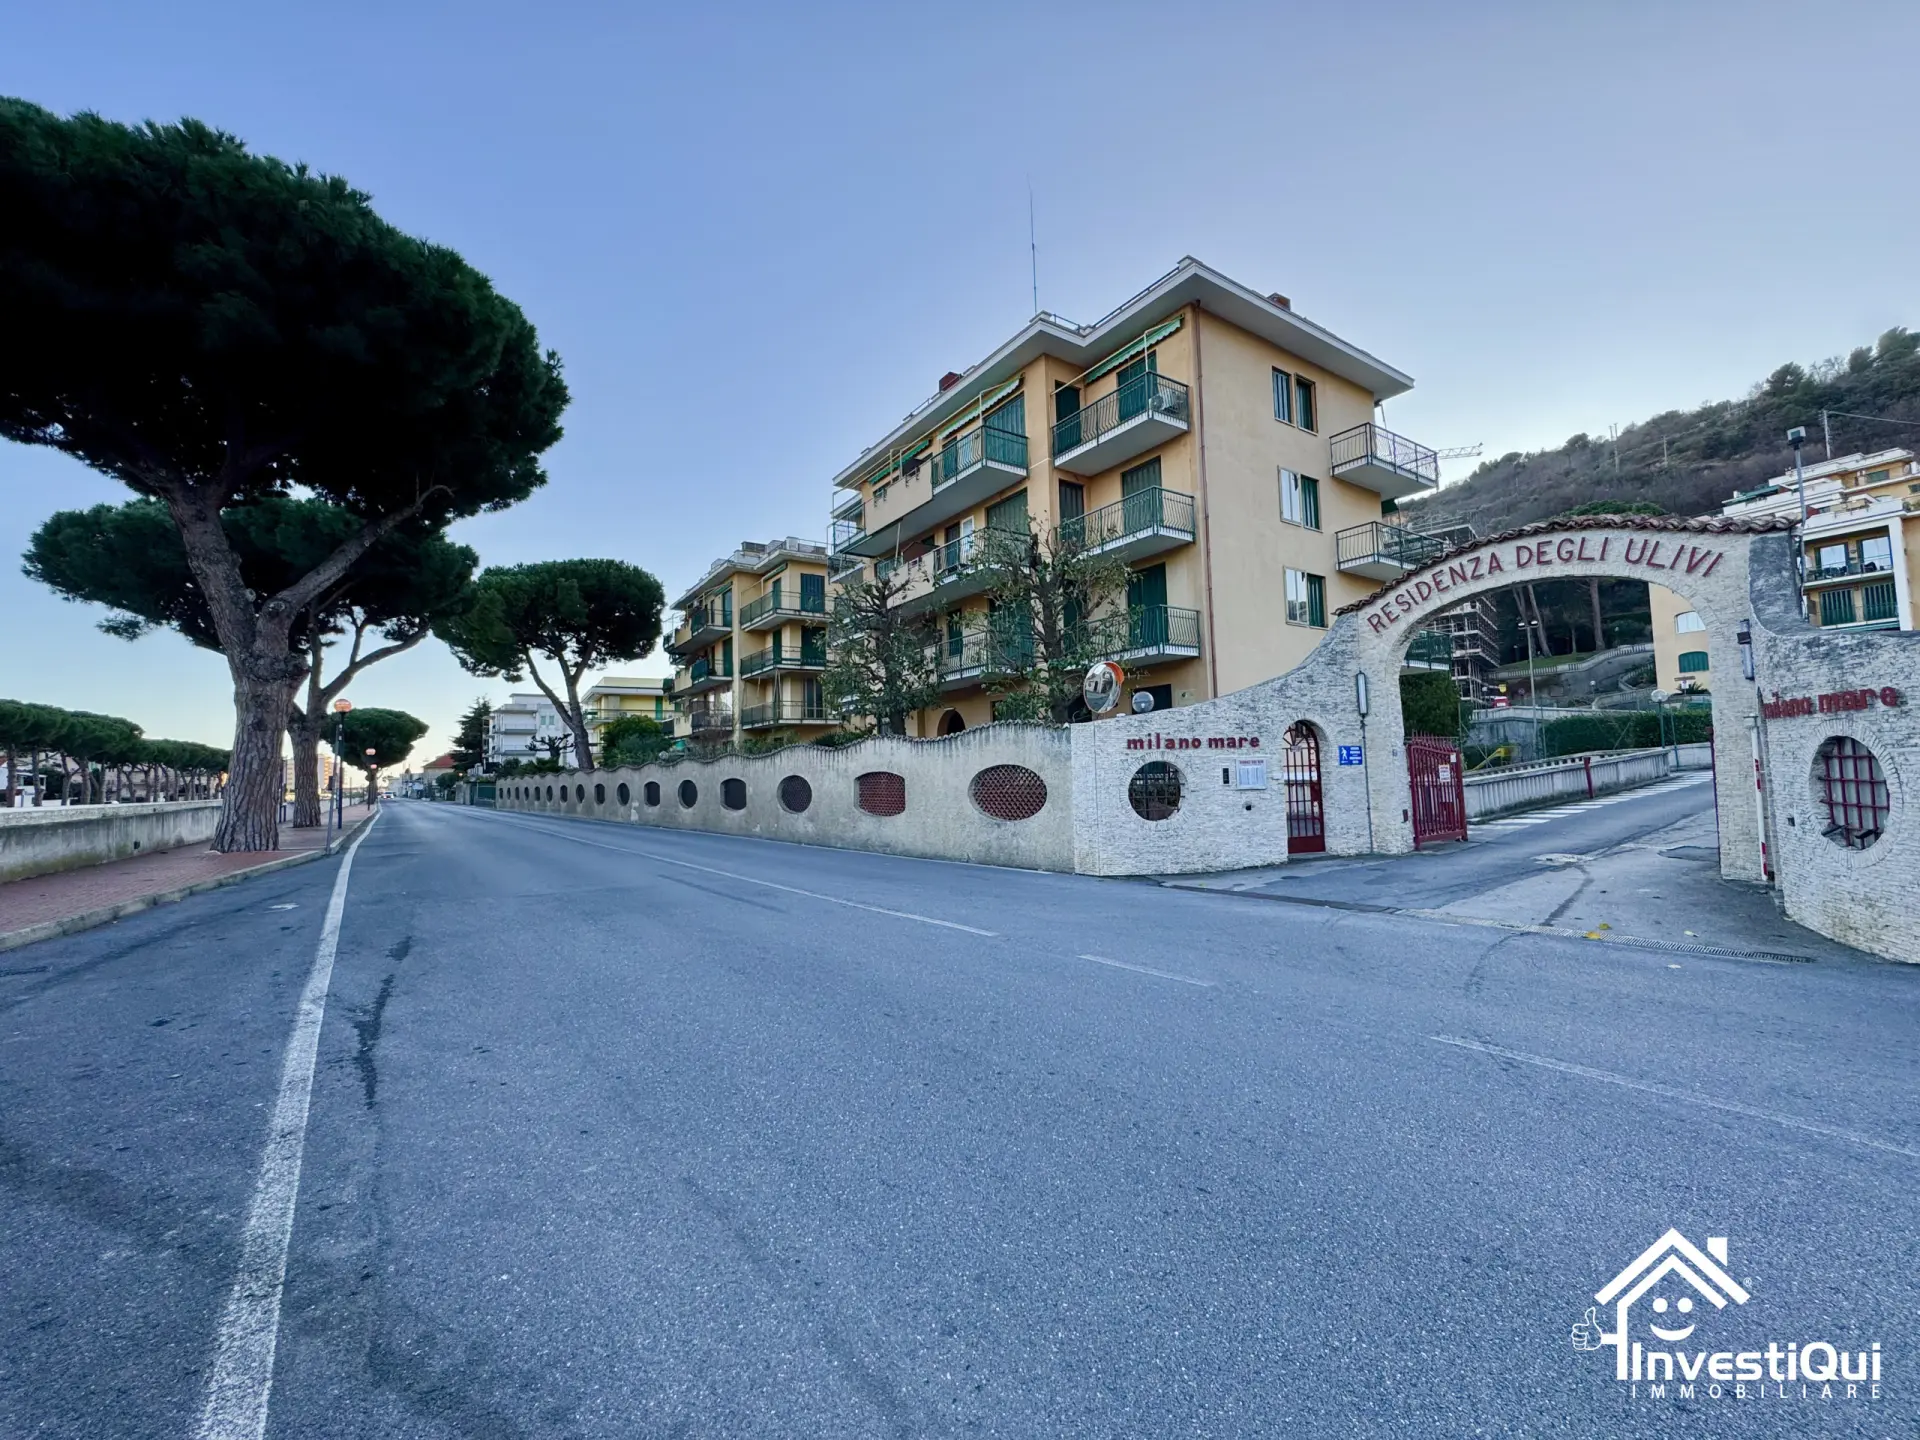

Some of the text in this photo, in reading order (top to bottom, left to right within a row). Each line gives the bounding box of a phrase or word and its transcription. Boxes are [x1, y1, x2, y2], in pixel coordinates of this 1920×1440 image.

[1367, 537, 1723, 633] RESIDENZA DEGLI ULIVI
[1818, 686, 1897, 713] mare
[1127, 732, 1260, 750] milano mare
